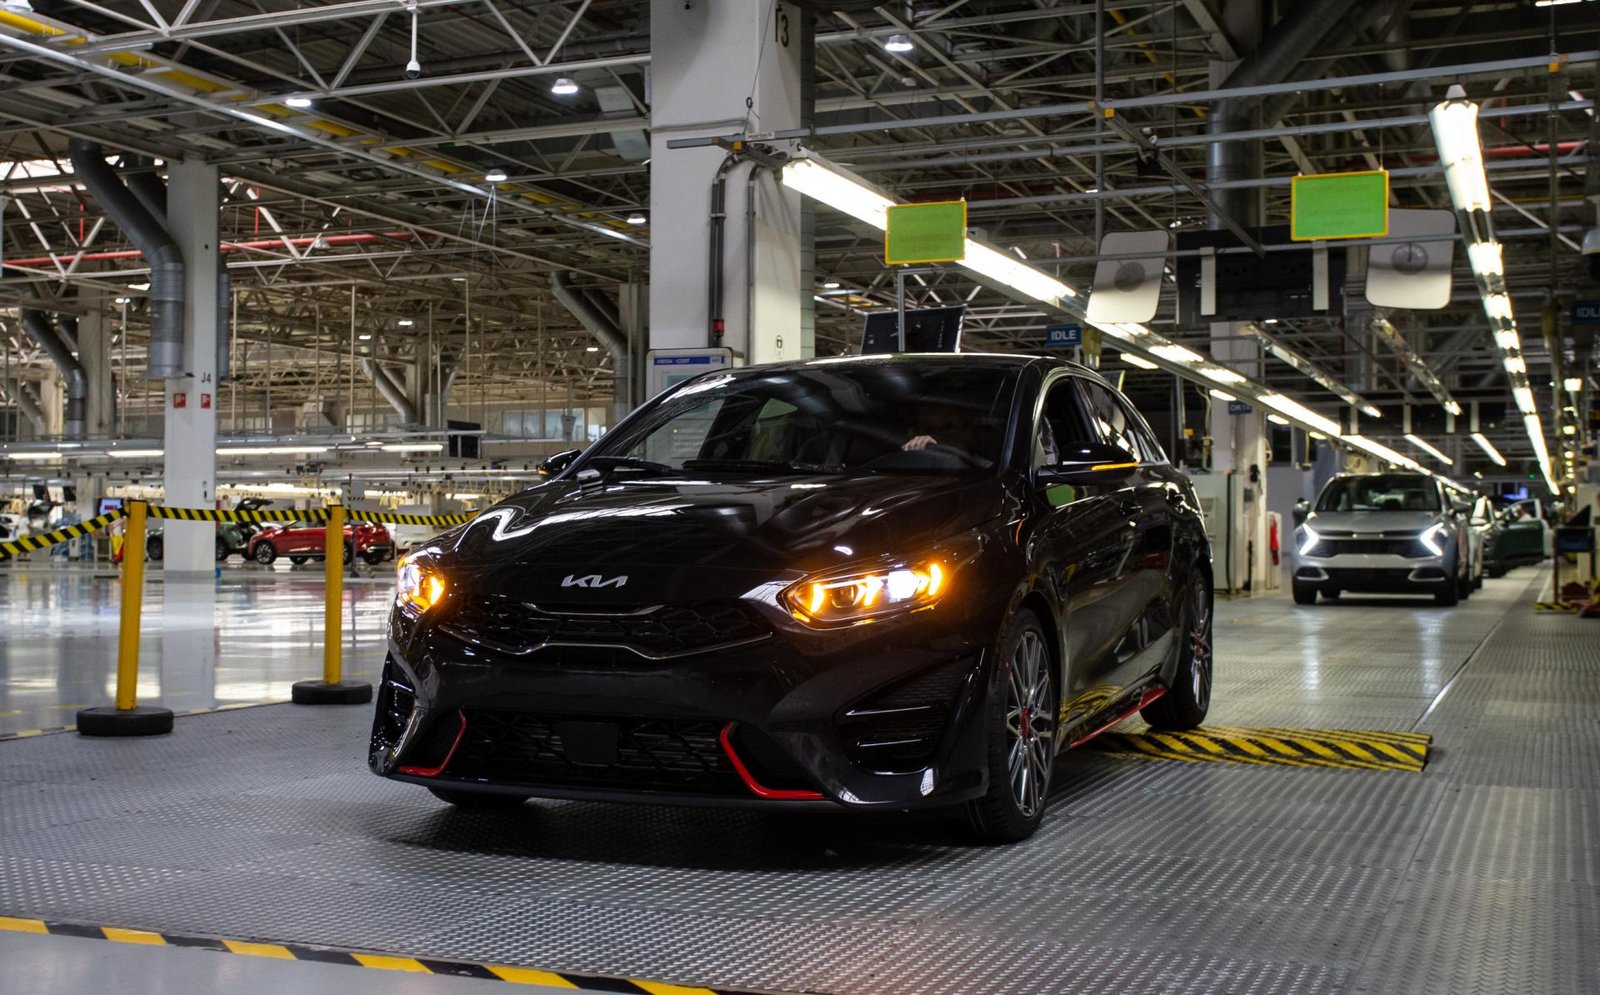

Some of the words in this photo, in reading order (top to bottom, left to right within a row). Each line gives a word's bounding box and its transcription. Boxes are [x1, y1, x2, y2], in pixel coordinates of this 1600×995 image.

[1051, 330, 1077, 341] IDLE
[200, 372, 212, 384] J4
[560, 574, 629, 588] KIA
